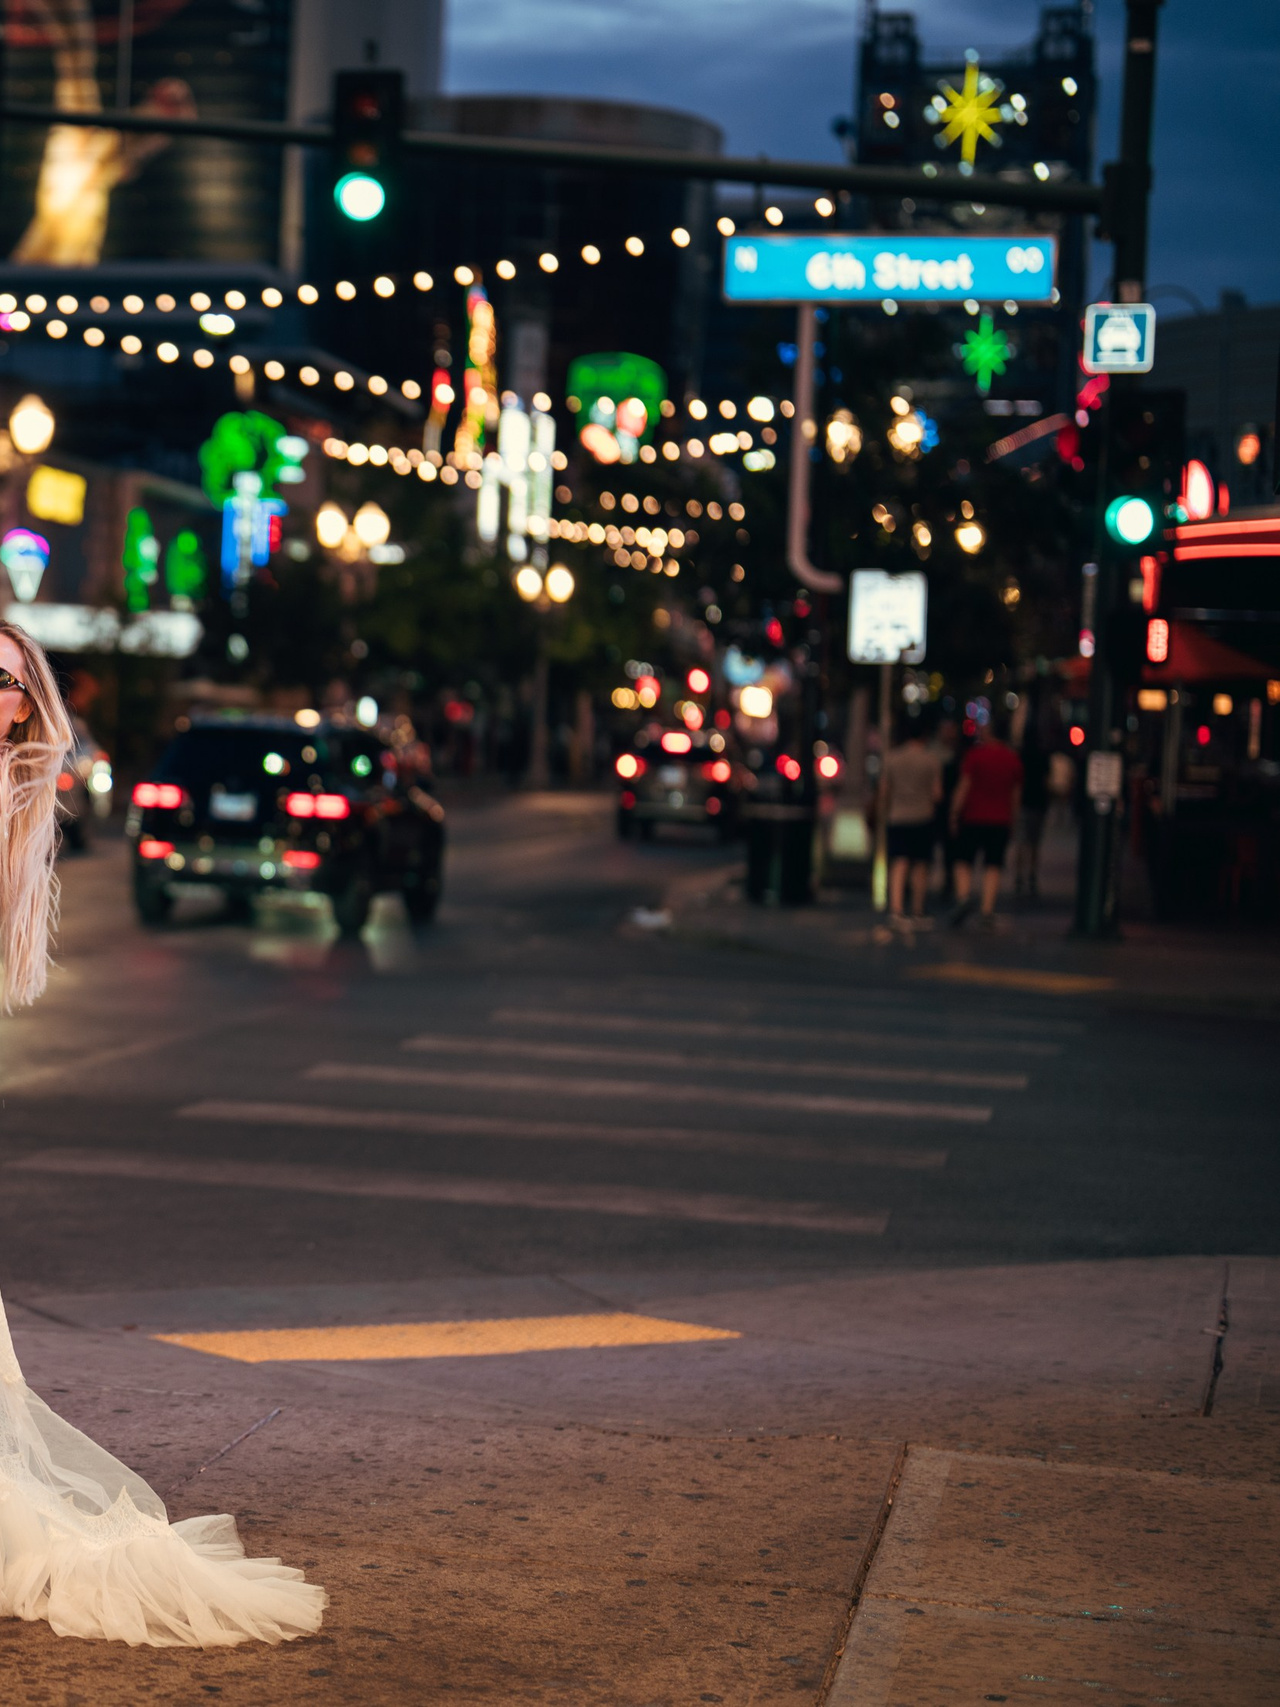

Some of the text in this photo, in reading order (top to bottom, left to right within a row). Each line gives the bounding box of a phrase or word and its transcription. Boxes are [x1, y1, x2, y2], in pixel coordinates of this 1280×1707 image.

[735, 246, 757, 273] N
[806, 252, 865, 290] 6th
[873, 252, 973, 290] Street
